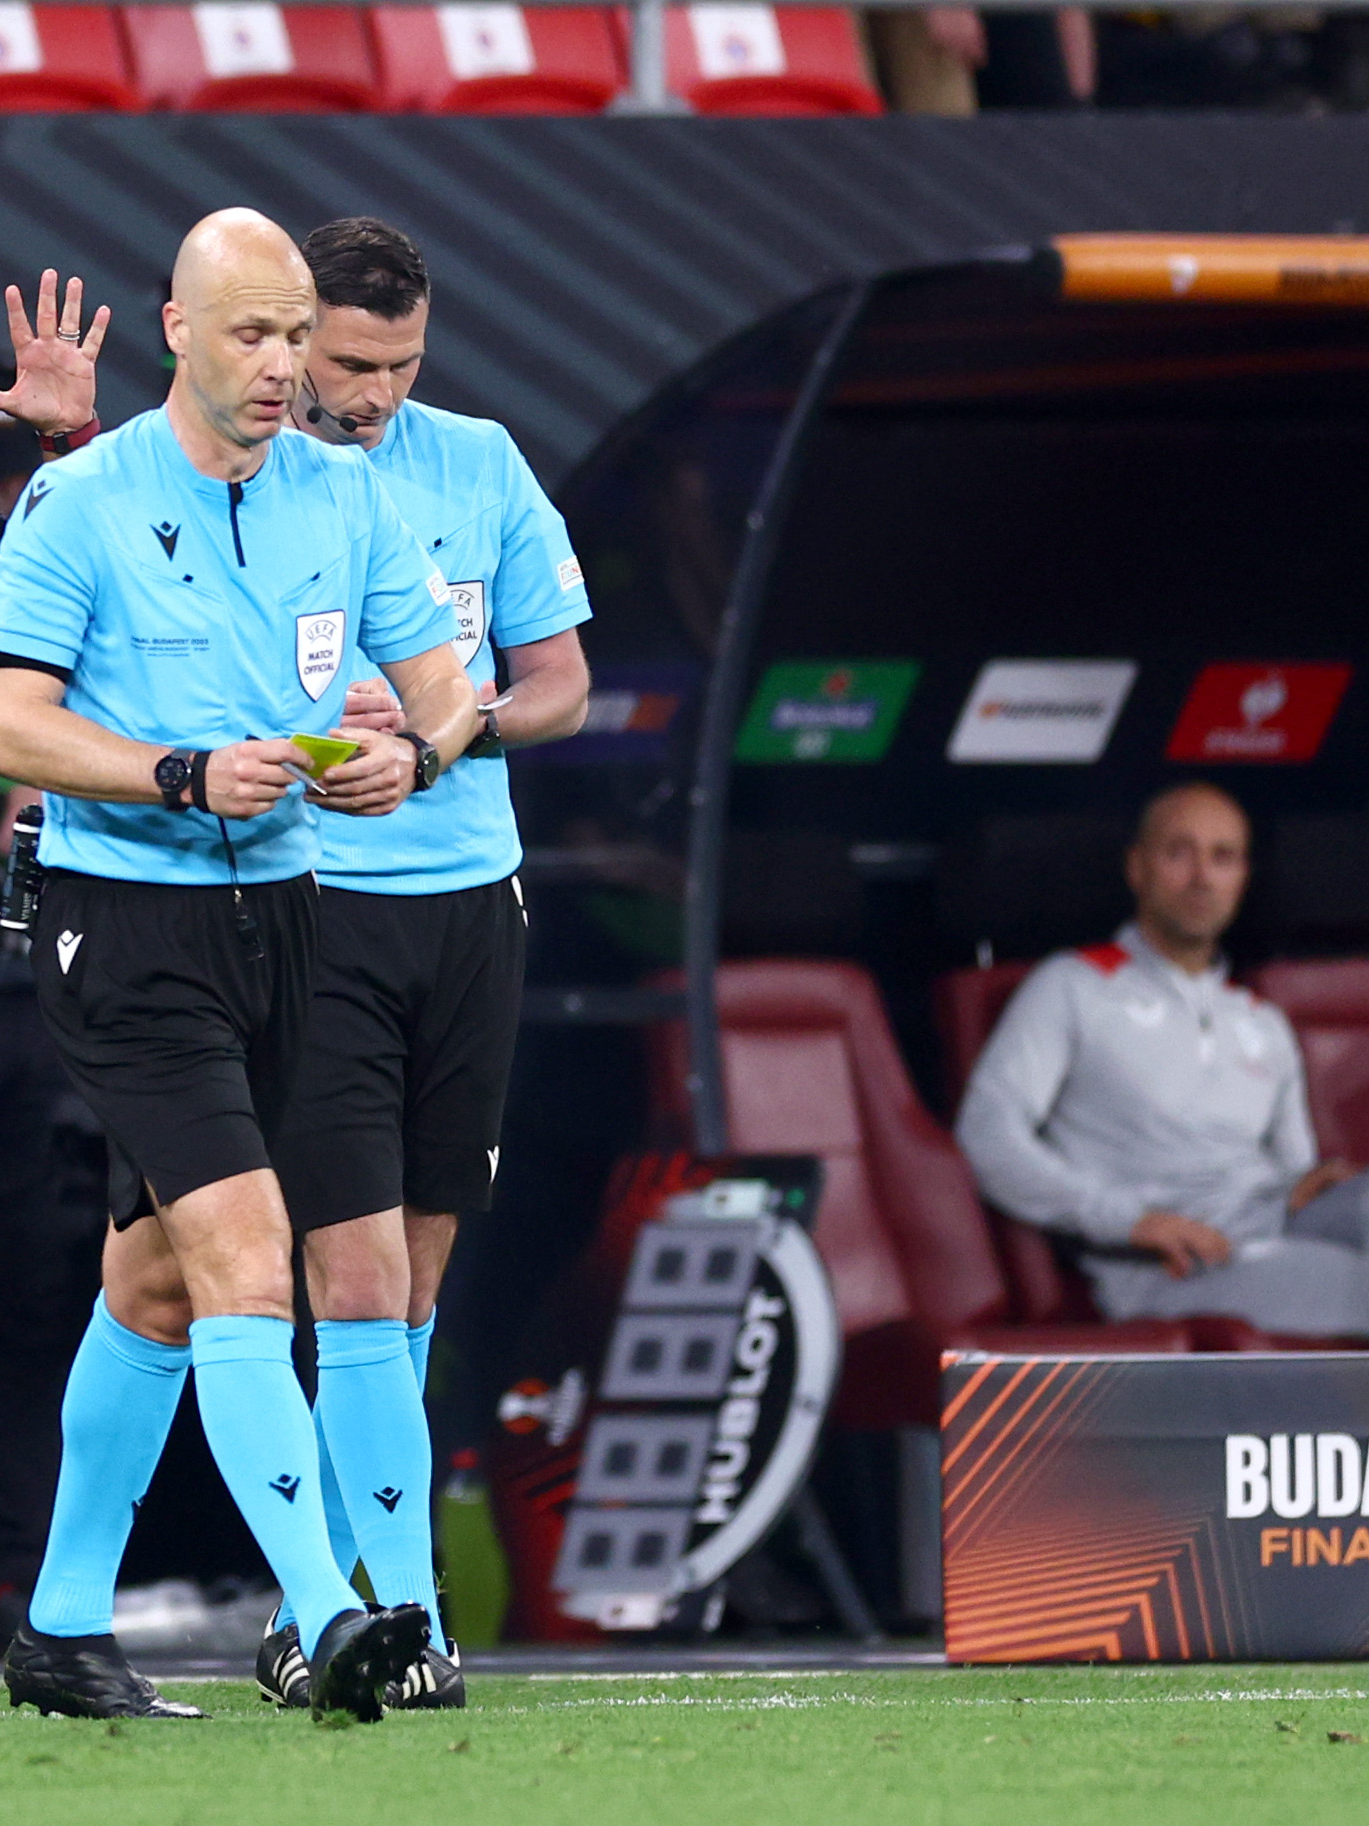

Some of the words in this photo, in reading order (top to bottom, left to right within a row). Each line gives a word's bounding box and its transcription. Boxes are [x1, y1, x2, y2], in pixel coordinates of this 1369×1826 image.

[458, 618, 473, 627] CH
[306, 623, 334, 640] UEFA
[308, 649, 334, 661] MATCH
[304, 662, 335, 675] OFFICIAL
[695, 1286, 785, 1524] HUBLOT
[1225, 1433, 1369, 1519] BUD
